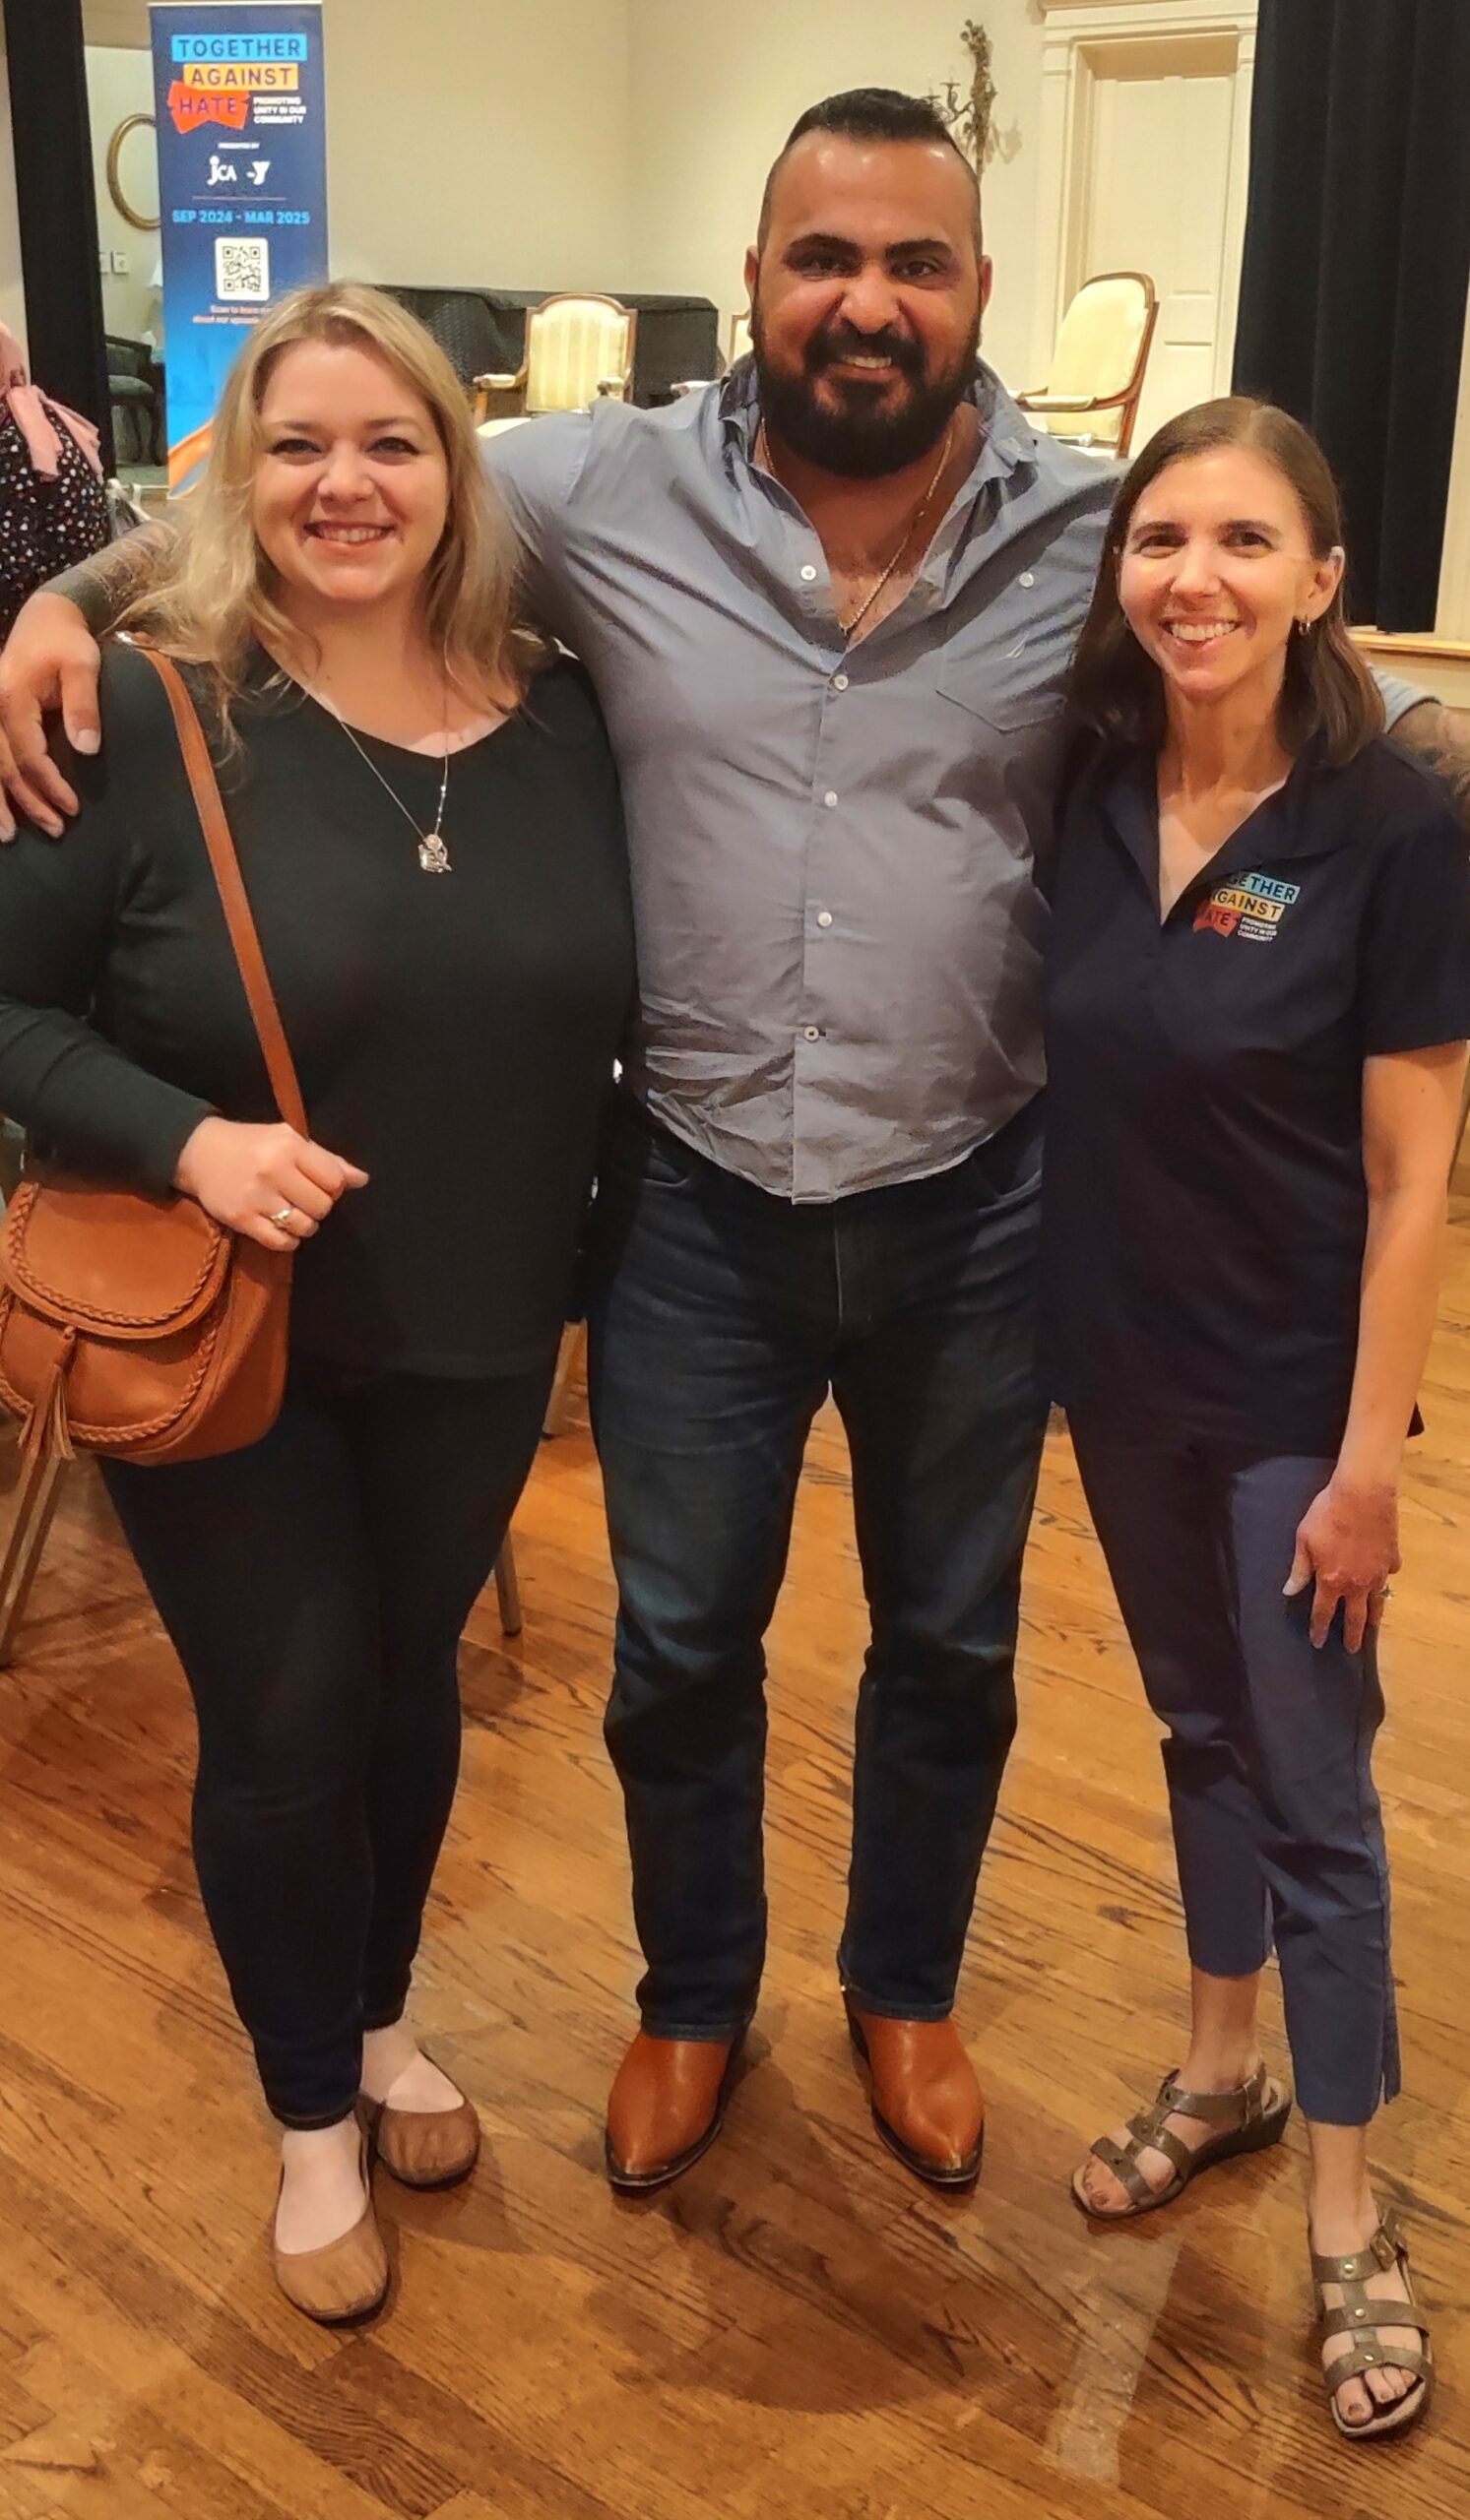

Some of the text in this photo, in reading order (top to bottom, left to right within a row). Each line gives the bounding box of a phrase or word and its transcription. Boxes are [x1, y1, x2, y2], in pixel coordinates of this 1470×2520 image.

[177, 38, 301, 57] TOGETHER
[191, 67, 292, 86] AGAINST
[179, 96, 237, 115] HATE
[253, 96, 301, 105] PROMOTING
[253, 106, 306, 115] UNITY IN OUR
[253, 115, 304, 125] COMMUNITY
[171, 210, 196, 223] SEP
[198, 210, 233, 223] 2024
[244, 211, 274, 224] MAR
[276, 211, 311, 225] 2025
[1229, 873, 1297, 902] GETHER
[1203, 909, 1233, 926] ATE
